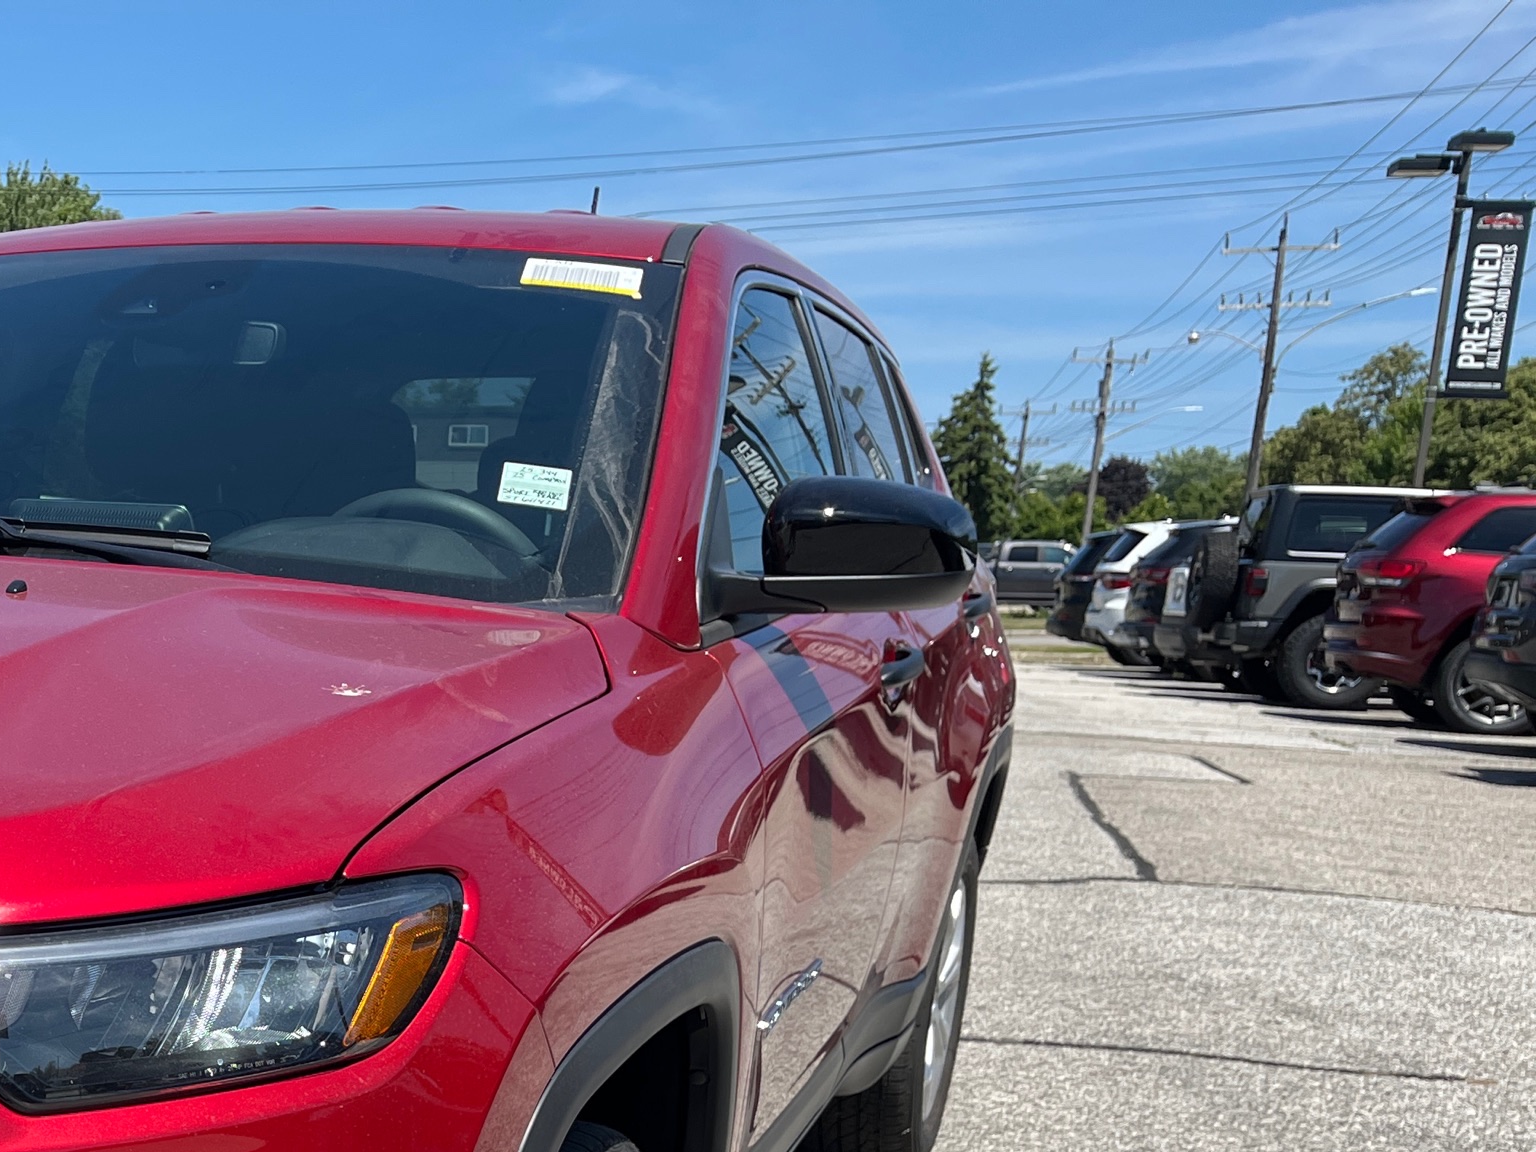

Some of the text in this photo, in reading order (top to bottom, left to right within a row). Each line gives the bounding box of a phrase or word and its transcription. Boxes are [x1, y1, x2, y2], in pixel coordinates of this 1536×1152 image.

[1456, 243, 1503, 369] PRE-OWNED
[1485, 244, 1518, 370] ALL MAKES AND MODELS
